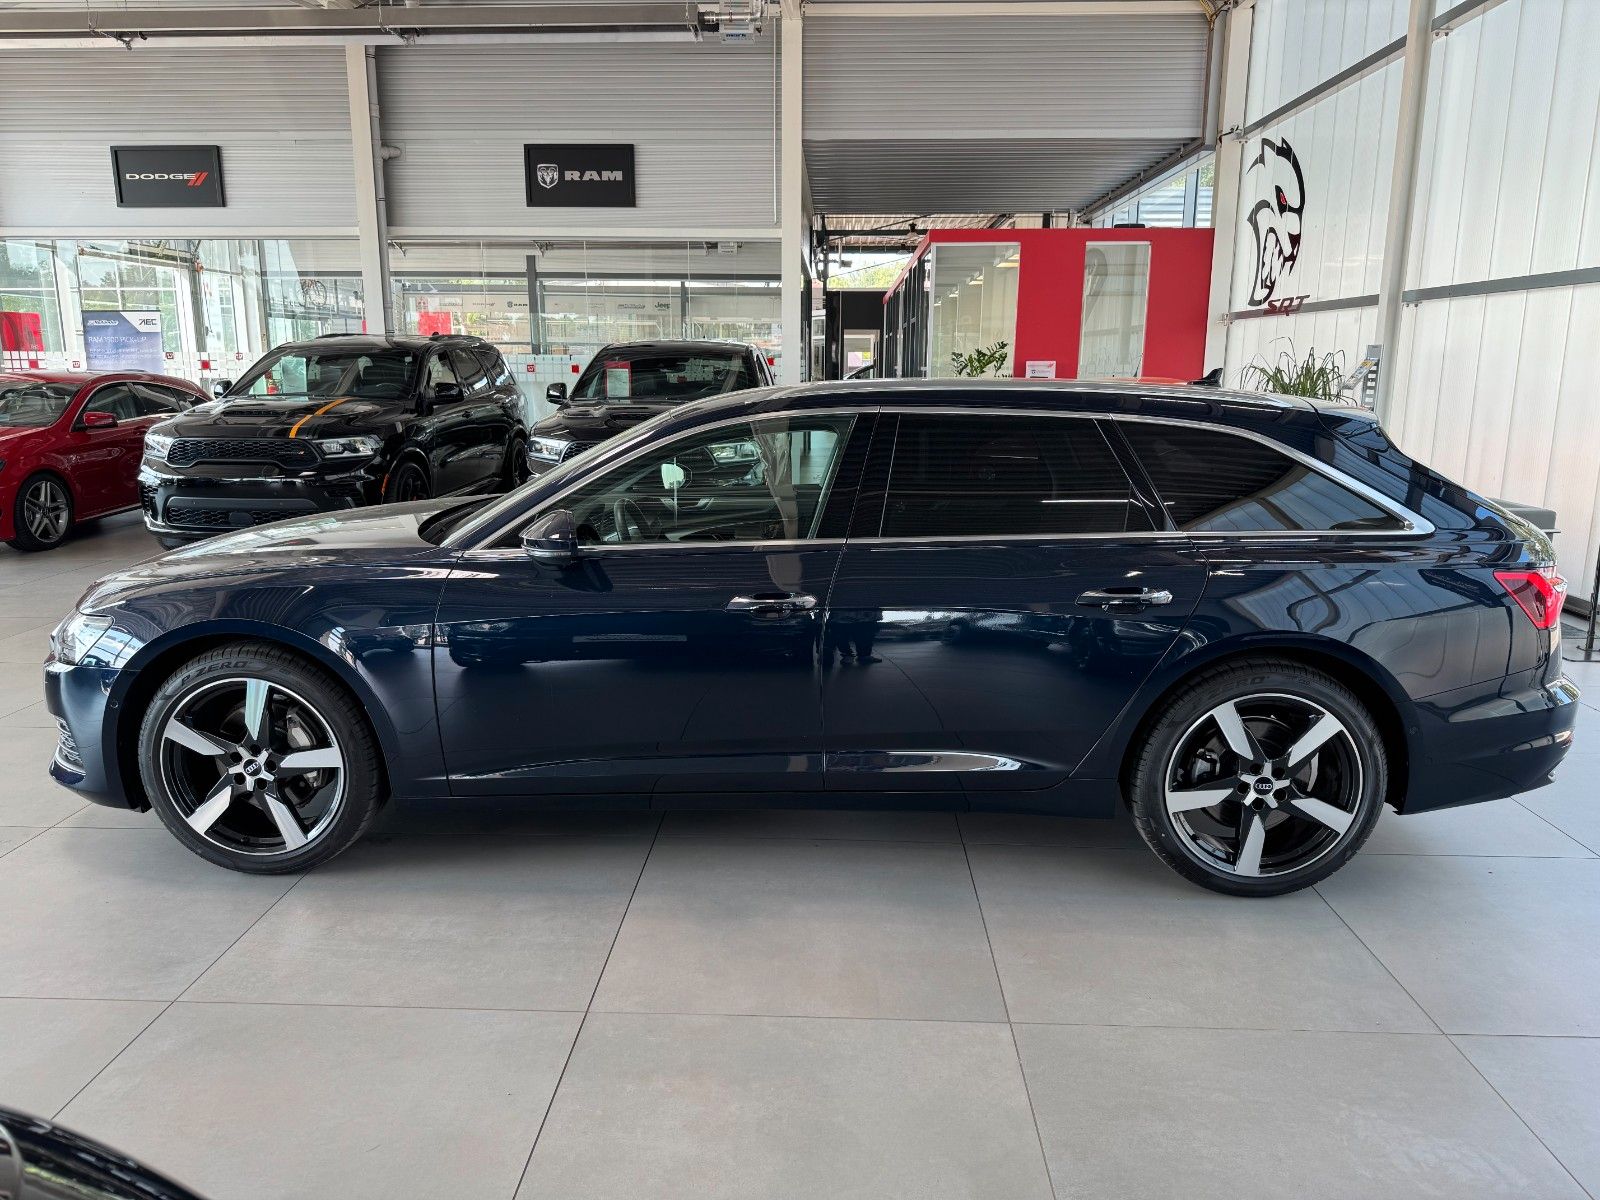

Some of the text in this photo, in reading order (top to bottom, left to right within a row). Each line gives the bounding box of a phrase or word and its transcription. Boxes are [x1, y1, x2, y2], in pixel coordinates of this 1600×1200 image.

[564, 170, 623, 181] RAM
[1264, 295, 1311, 316] SRT
[181, 660, 248, 686] P ZERO
